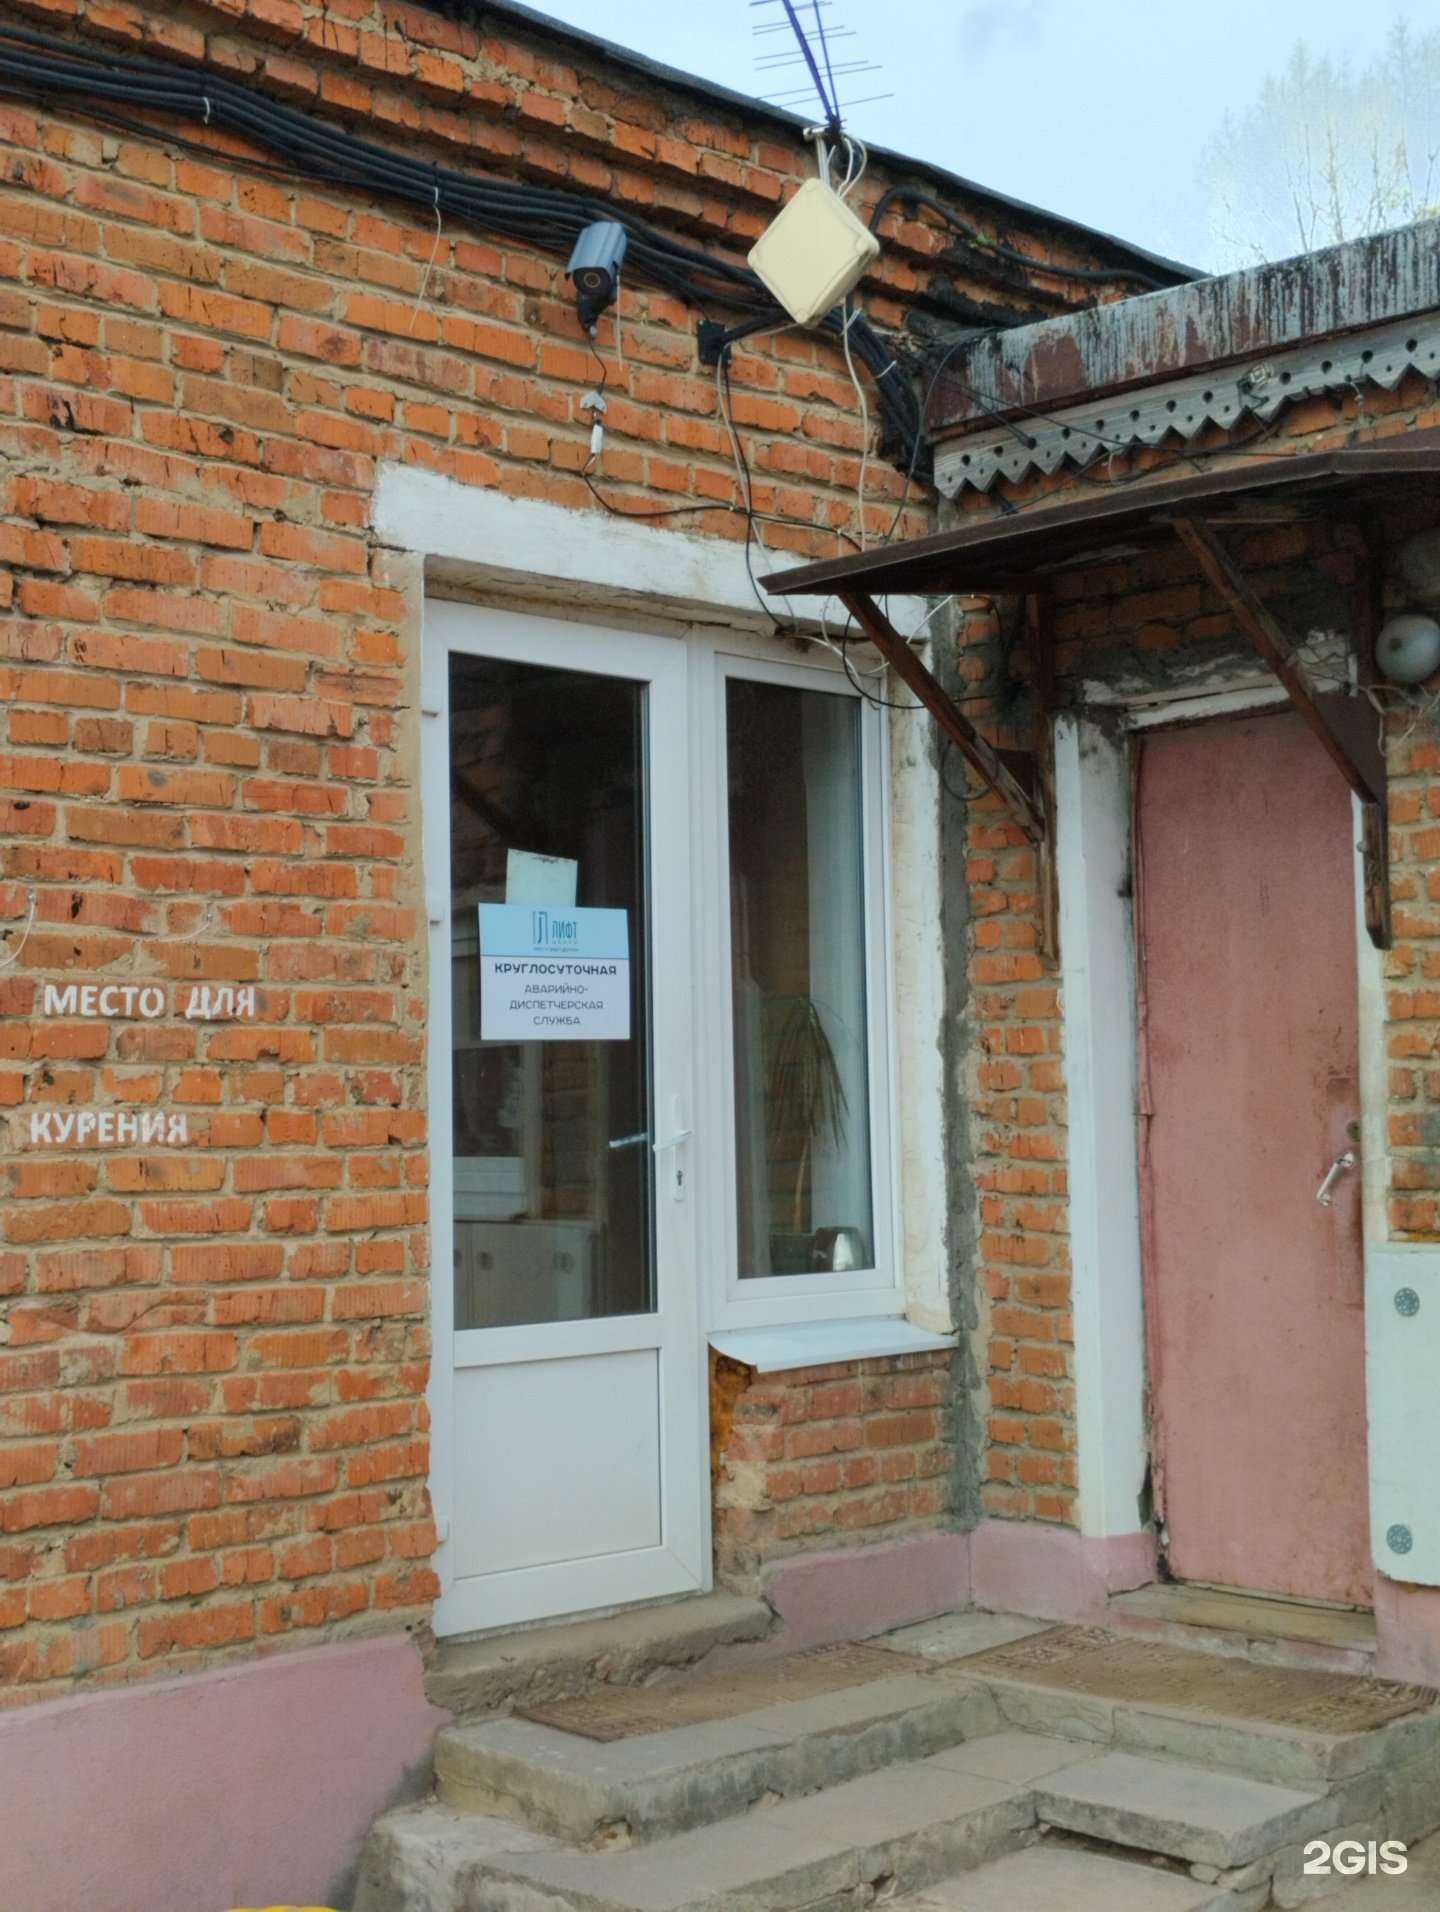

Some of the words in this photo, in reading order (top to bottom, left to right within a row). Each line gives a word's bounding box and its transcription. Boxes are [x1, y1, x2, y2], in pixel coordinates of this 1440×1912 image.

[551, 920, 578, 939] ЛИФТ
[494, 963, 617, 976] КРУГЛОСУТОЧНАЯ
[524, 982, 589, 995] АВАРИЙНО-
[44, 984, 165, 1017] МЕСТО
[185, 985, 255, 1019] ДЛЯ
[509, 999, 604, 1011] ДИСПЕТЧЕРСКАЯ
[533, 1015, 581, 1026] СЛУЖБА
[30, 1111, 189, 1143] КУРЕНИЯ
